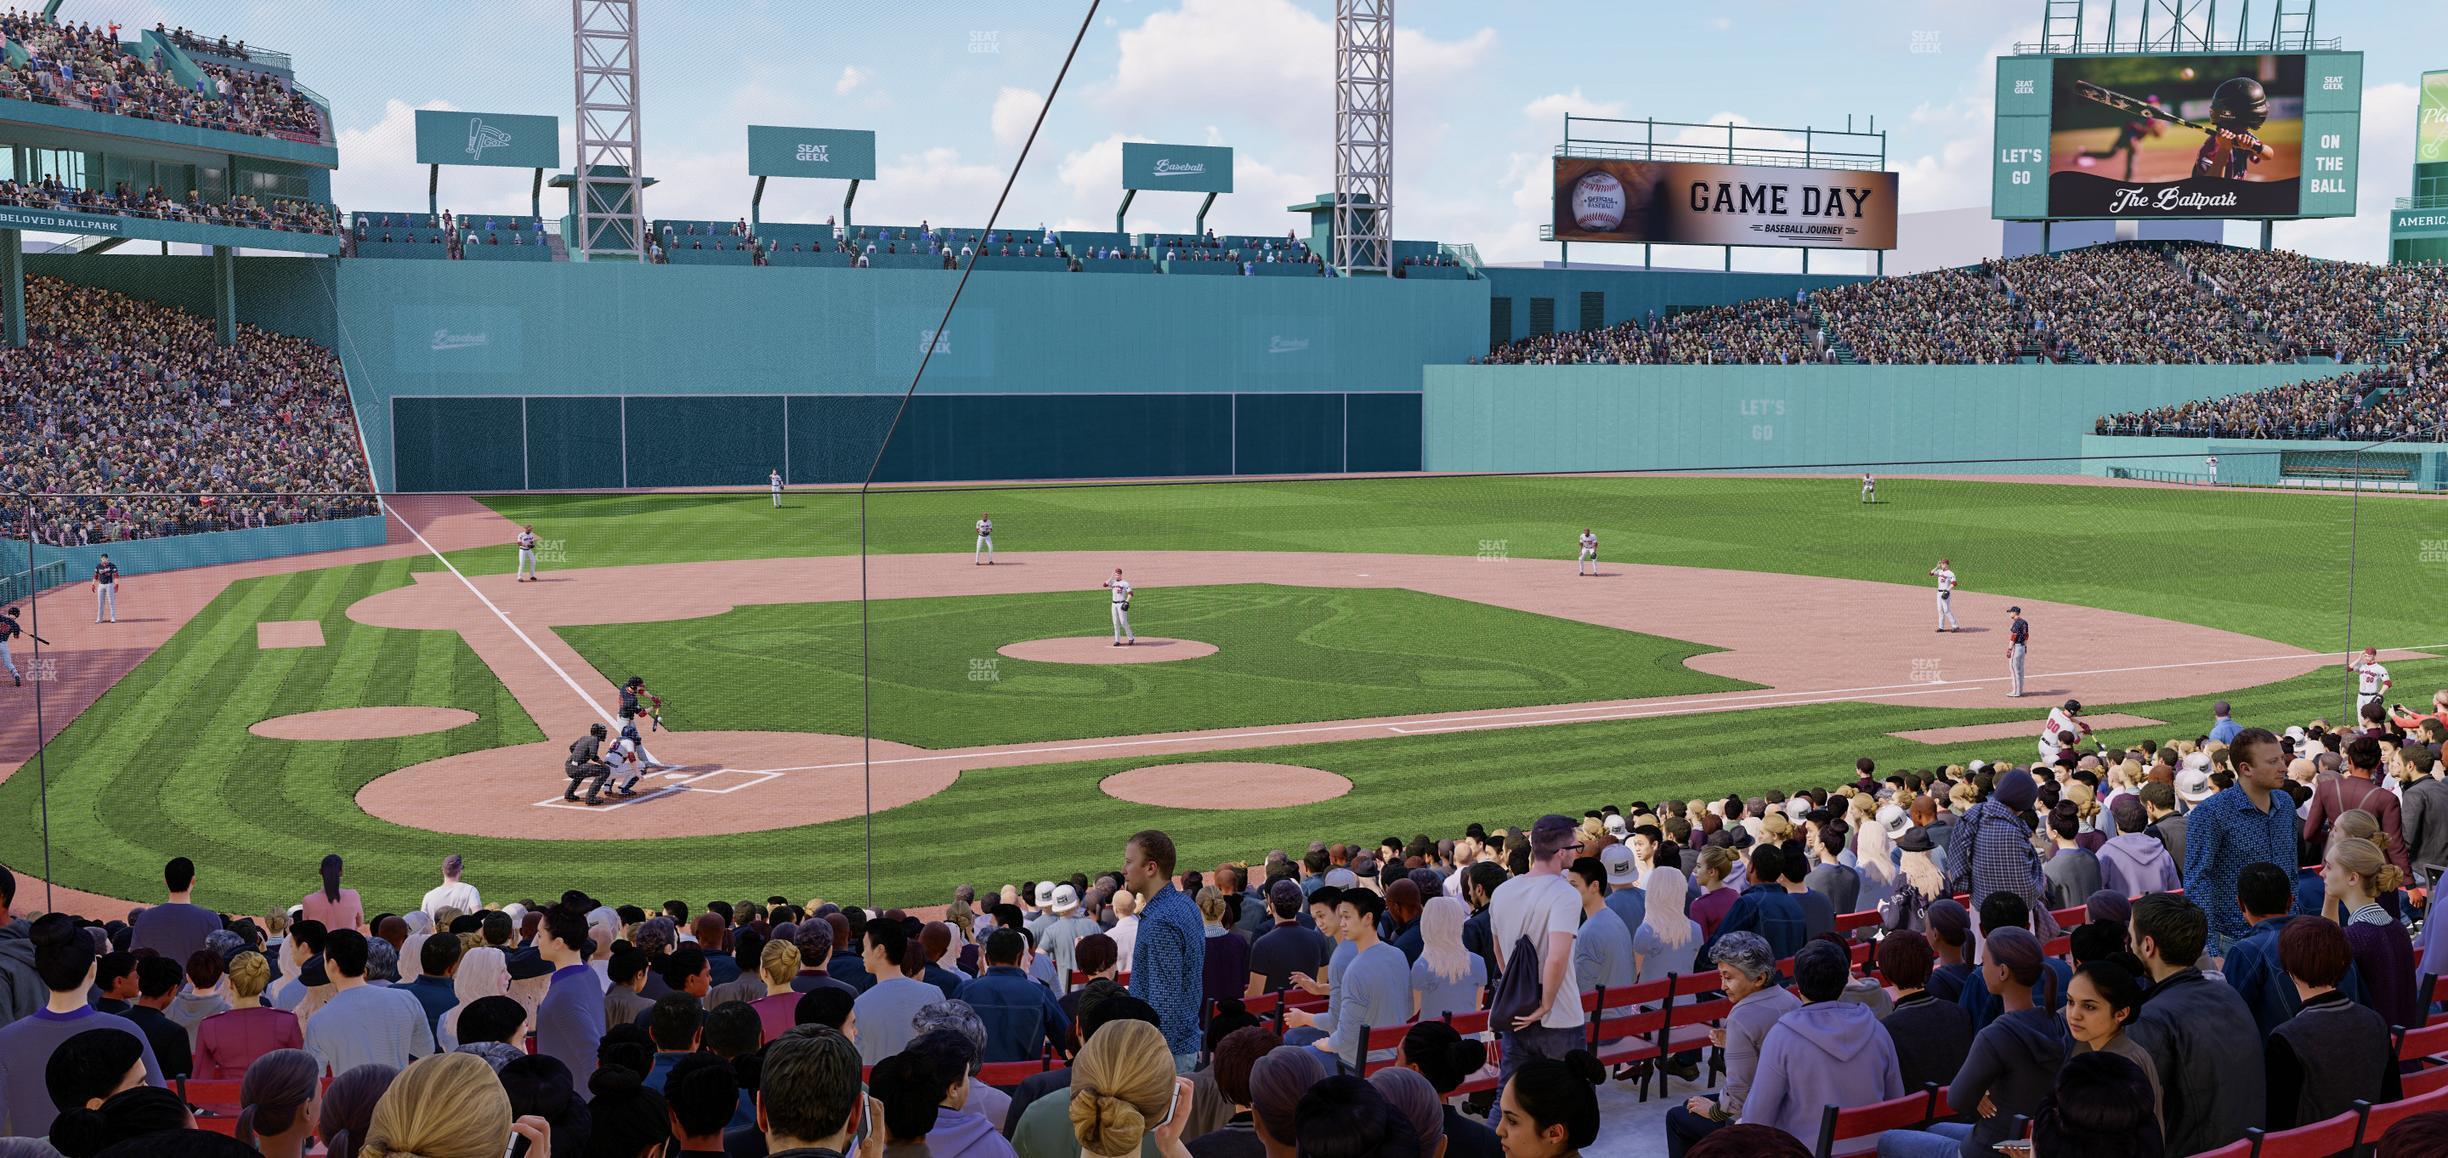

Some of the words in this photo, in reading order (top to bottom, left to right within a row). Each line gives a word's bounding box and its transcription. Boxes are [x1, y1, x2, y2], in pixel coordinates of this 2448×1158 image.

[797, 144, 828, 153] SEAT
[2320, 134, 2340, 149] ON
[796, 153, 829, 162] GEEK
[2002, 149, 2042, 163] LET'S
[1153, 158, 1206, 175] Baseball
[2315, 157, 2344, 171] THE
[2012, 171, 2031, 185] GO
[2310, 179, 2346, 193] BALL
[1690, 181, 1789, 215] GAME
[1802, 185, 1872, 218] DAY
[2109, 186, 2149, 213] The
[2152, 186, 2238, 210] Ballpark
[0, 213, 55, 226] BELOVED
[58, 218, 118, 231] BALLPARK
[2399, 215, 2448, 227] AMERIC
[1764, 224, 1804, 234] BASEBALL
[1805, 225, 1843, 235] JOURNEY
[1740, 399, 1785, 416] LET'S
[1752, 424, 1773, 441] GO
